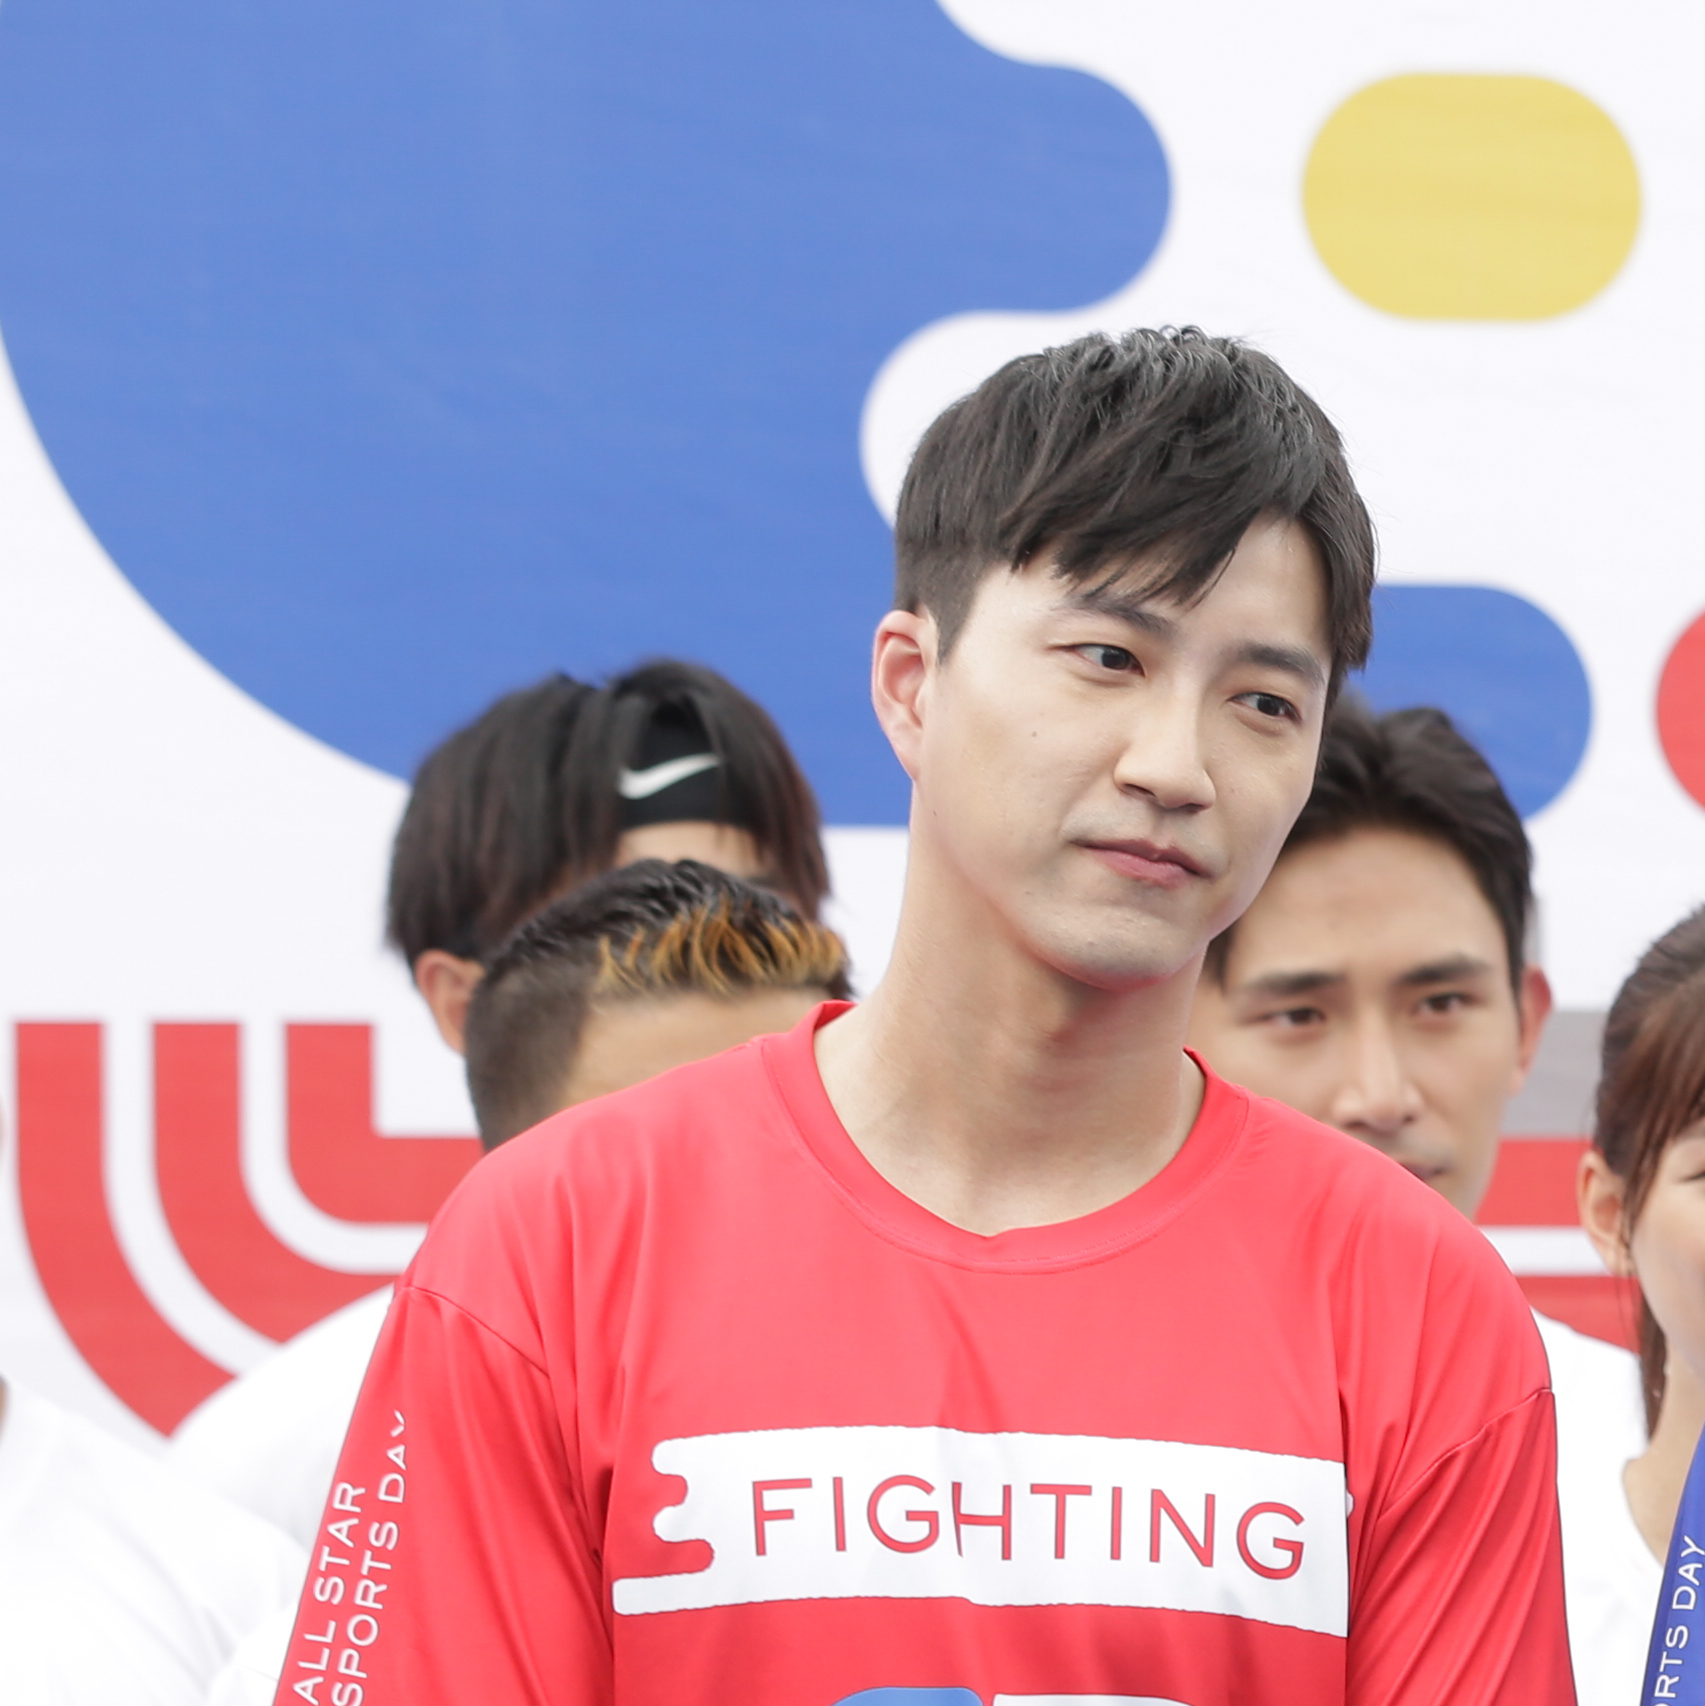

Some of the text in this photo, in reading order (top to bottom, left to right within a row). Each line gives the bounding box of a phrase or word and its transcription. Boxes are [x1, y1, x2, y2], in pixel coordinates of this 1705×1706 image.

[377, 1409, 407, 1503] DAY
[751, 1473, 1307, 1580] FIGHTING
[1671, 1535, 1705, 1610] DAY
[293, 1482, 366, 1706] ALL STAR
